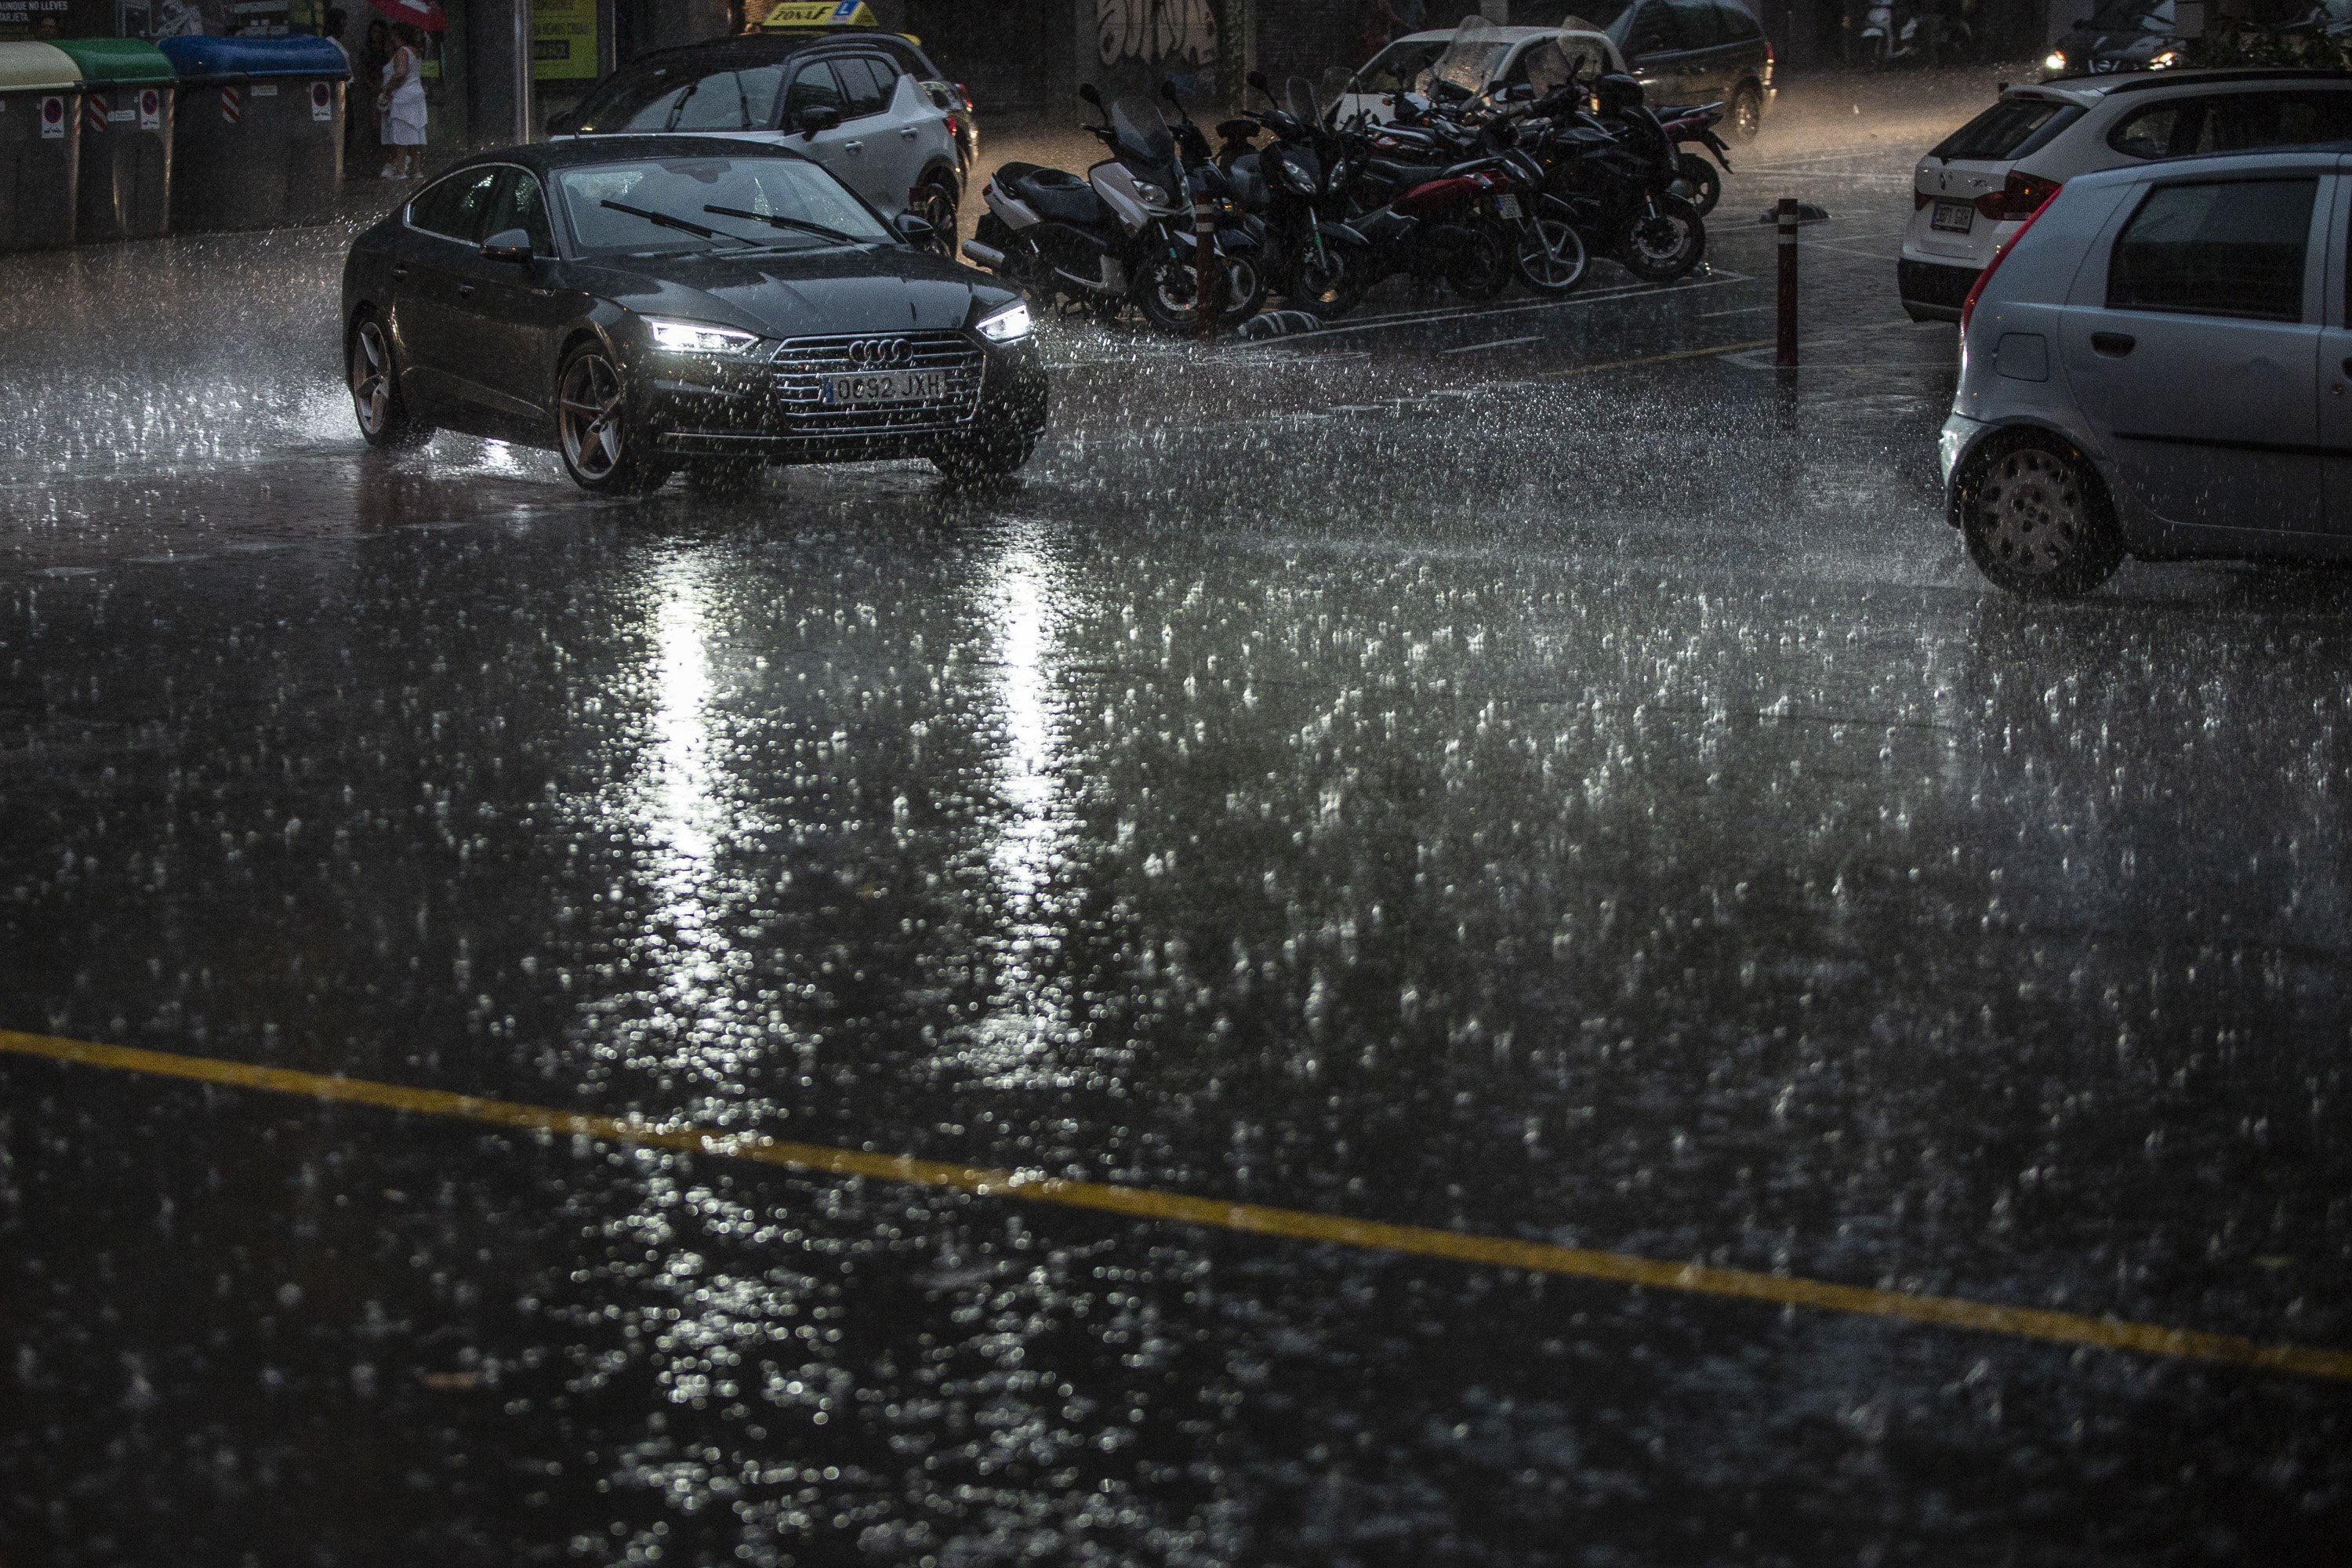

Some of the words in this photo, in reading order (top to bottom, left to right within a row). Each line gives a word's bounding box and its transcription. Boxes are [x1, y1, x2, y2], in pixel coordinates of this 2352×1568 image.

[28, 1, 39, 10] NO
[41, 1, 68, 10] LLEVES
[902, 375, 939, 397] JXH
